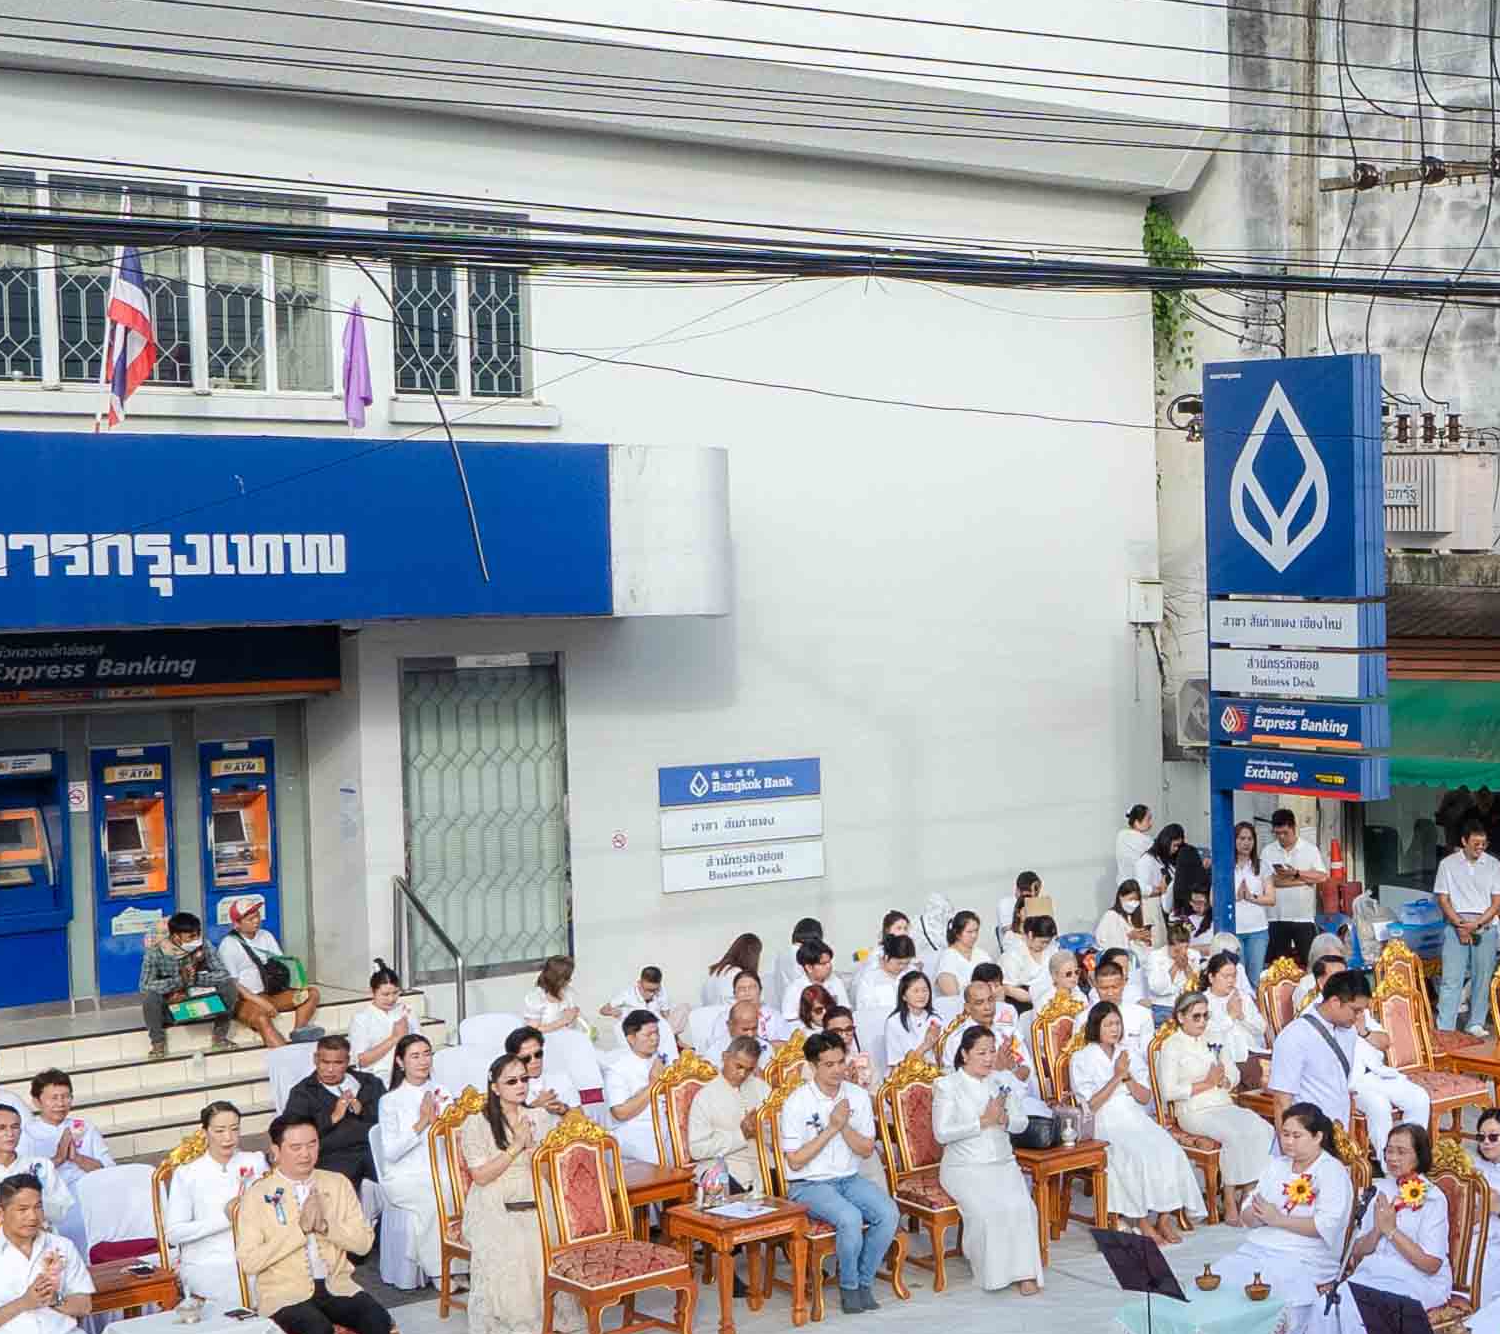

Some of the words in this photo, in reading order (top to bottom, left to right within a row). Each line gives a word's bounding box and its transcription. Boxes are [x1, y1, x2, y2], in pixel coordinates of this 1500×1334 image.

[97, 656, 196, 678] Banking
[1251, 675, 1290, 686] Business
[1293, 677, 1316, 688] Desk
[1253, 715, 1297, 731] Express
[1300, 718, 1349, 737] Banking
[128, 768, 153, 780] ATM
[1244, 765, 1299, 784] Exchange
[711, 778, 762, 794] Bangkok
[763, 776, 794, 789] Bank
[708, 869, 755, 881] Business
[757, 864, 783, 877] Desk
